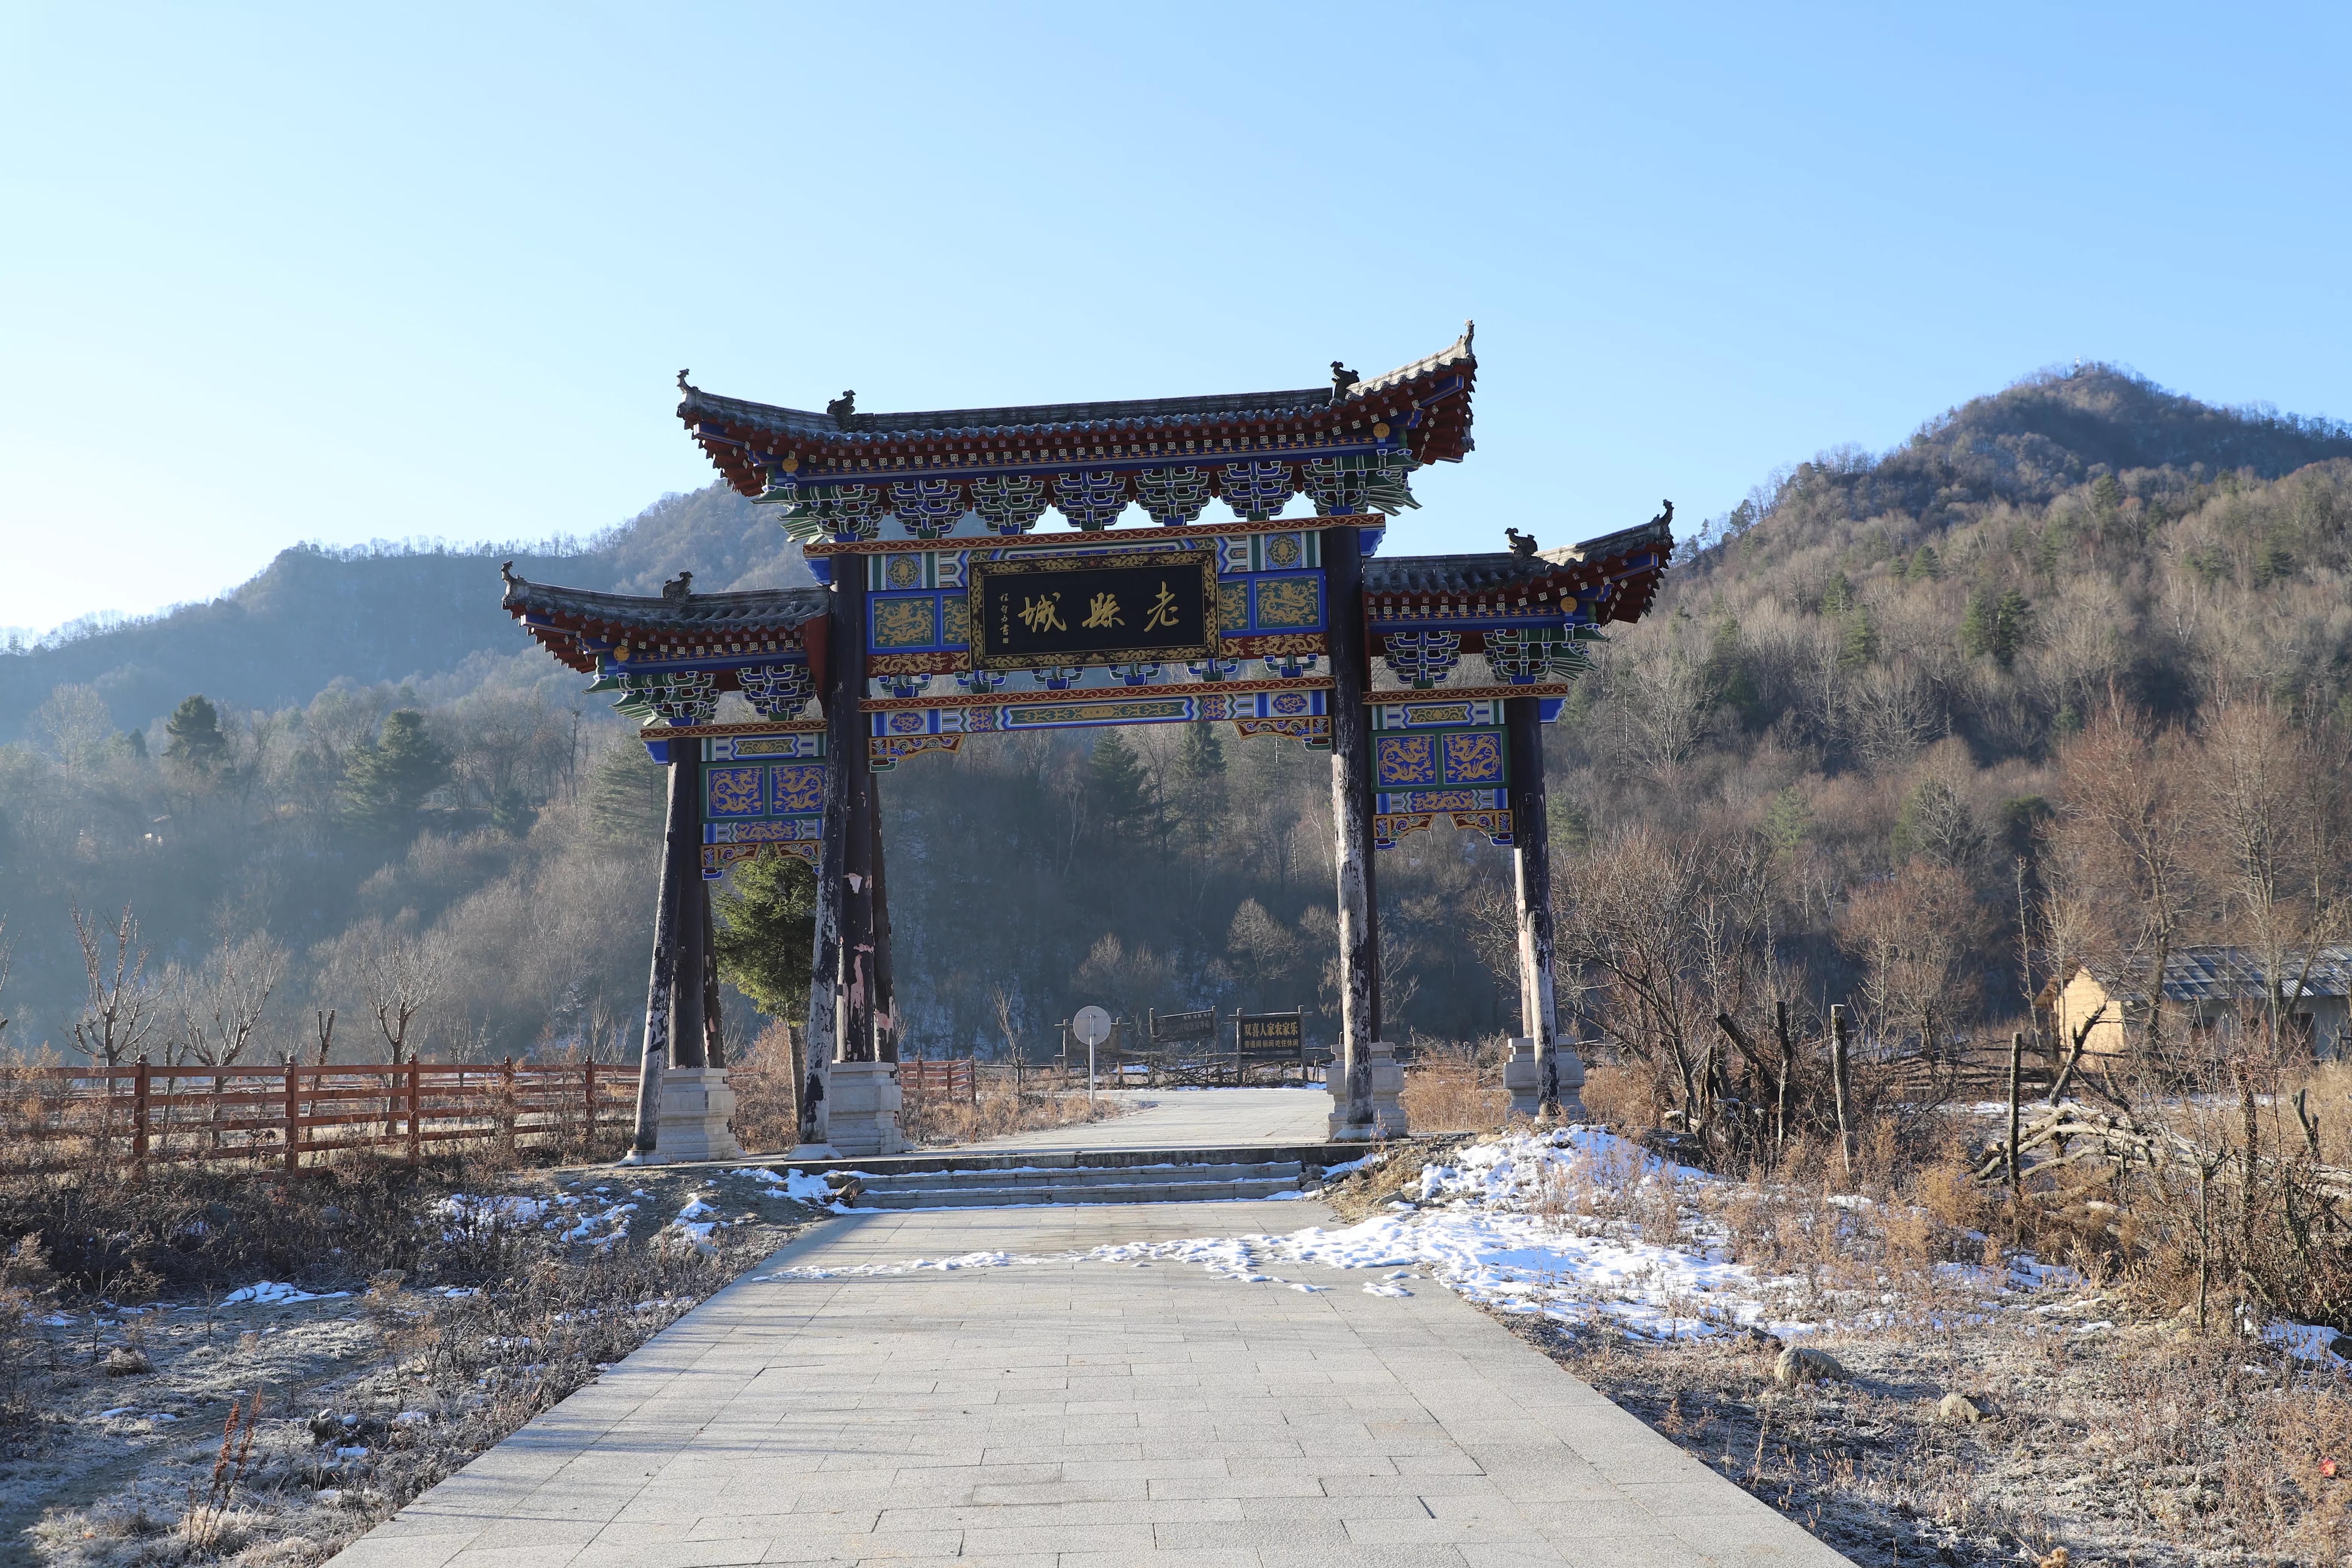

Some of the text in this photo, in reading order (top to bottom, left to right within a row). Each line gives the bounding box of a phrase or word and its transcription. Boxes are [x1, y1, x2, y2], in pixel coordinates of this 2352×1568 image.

[1018, 581, 1179, 632] 老縣城
[1244, 1021, 1298, 1037] 双喜人家农家乐
[1244, 1040, 1262, 1048] 普通间
[1275, 1039, 1298, 1047] 吃住休闲
